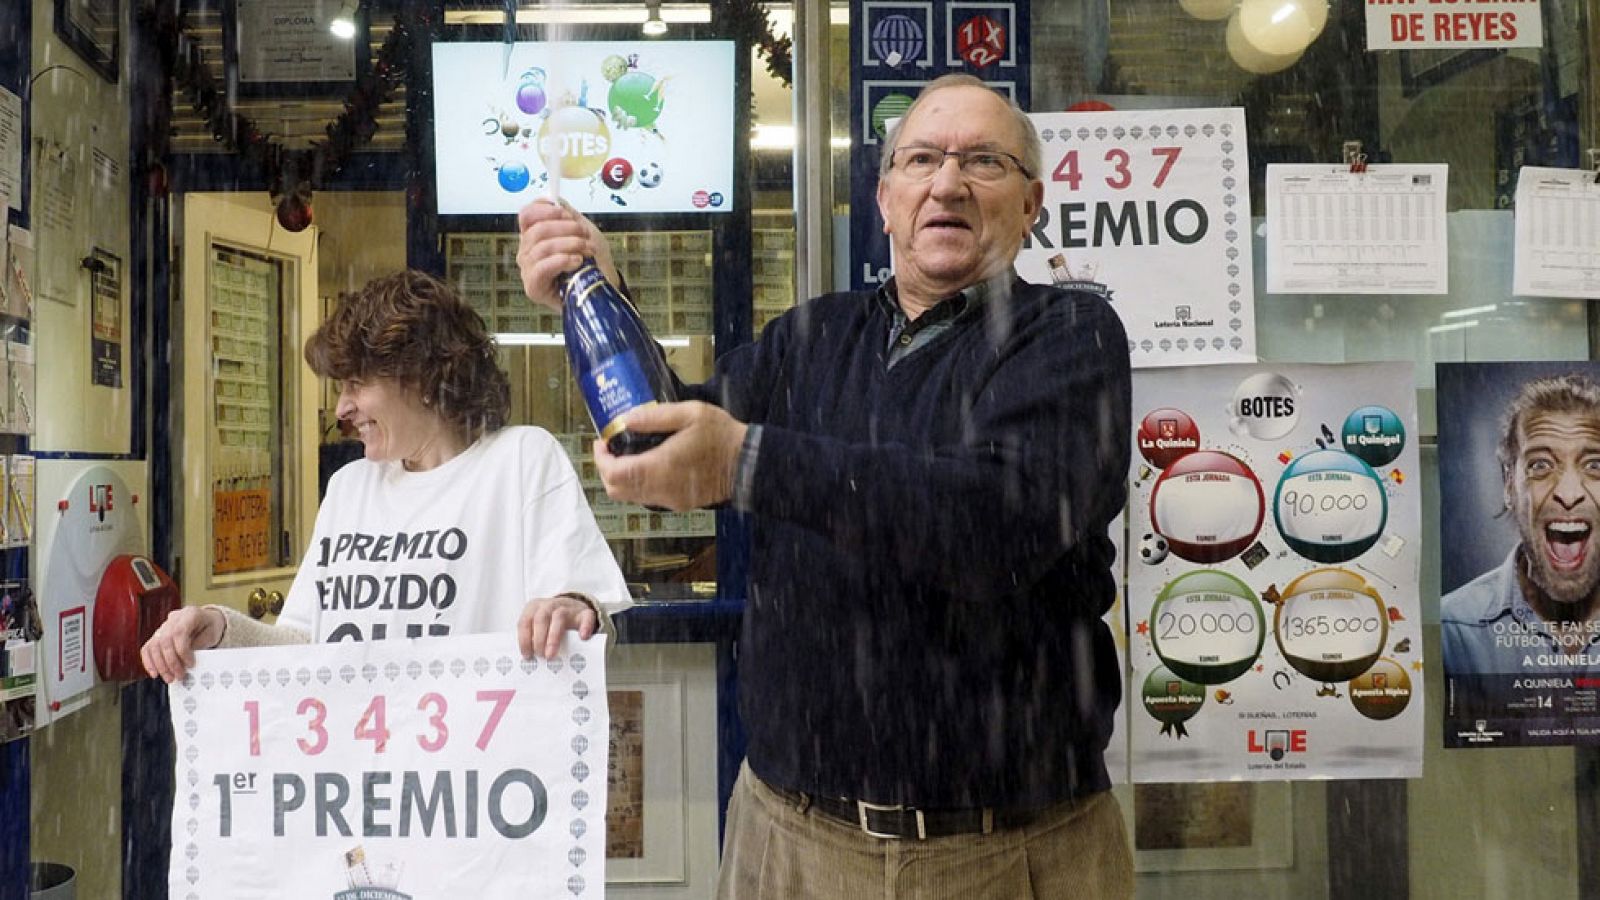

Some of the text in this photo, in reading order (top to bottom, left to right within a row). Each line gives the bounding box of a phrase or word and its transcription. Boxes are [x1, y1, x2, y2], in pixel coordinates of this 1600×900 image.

[1391, 12, 1518, 42] DE REYES
[1240, 396, 1294, 418] BOTES
[1142, 437, 1196, 449] La Quiniela
[332, 527, 468, 562] PREMIO
[1522, 655, 1534, 667] A
[273, 768, 548, 839] PREMIO
